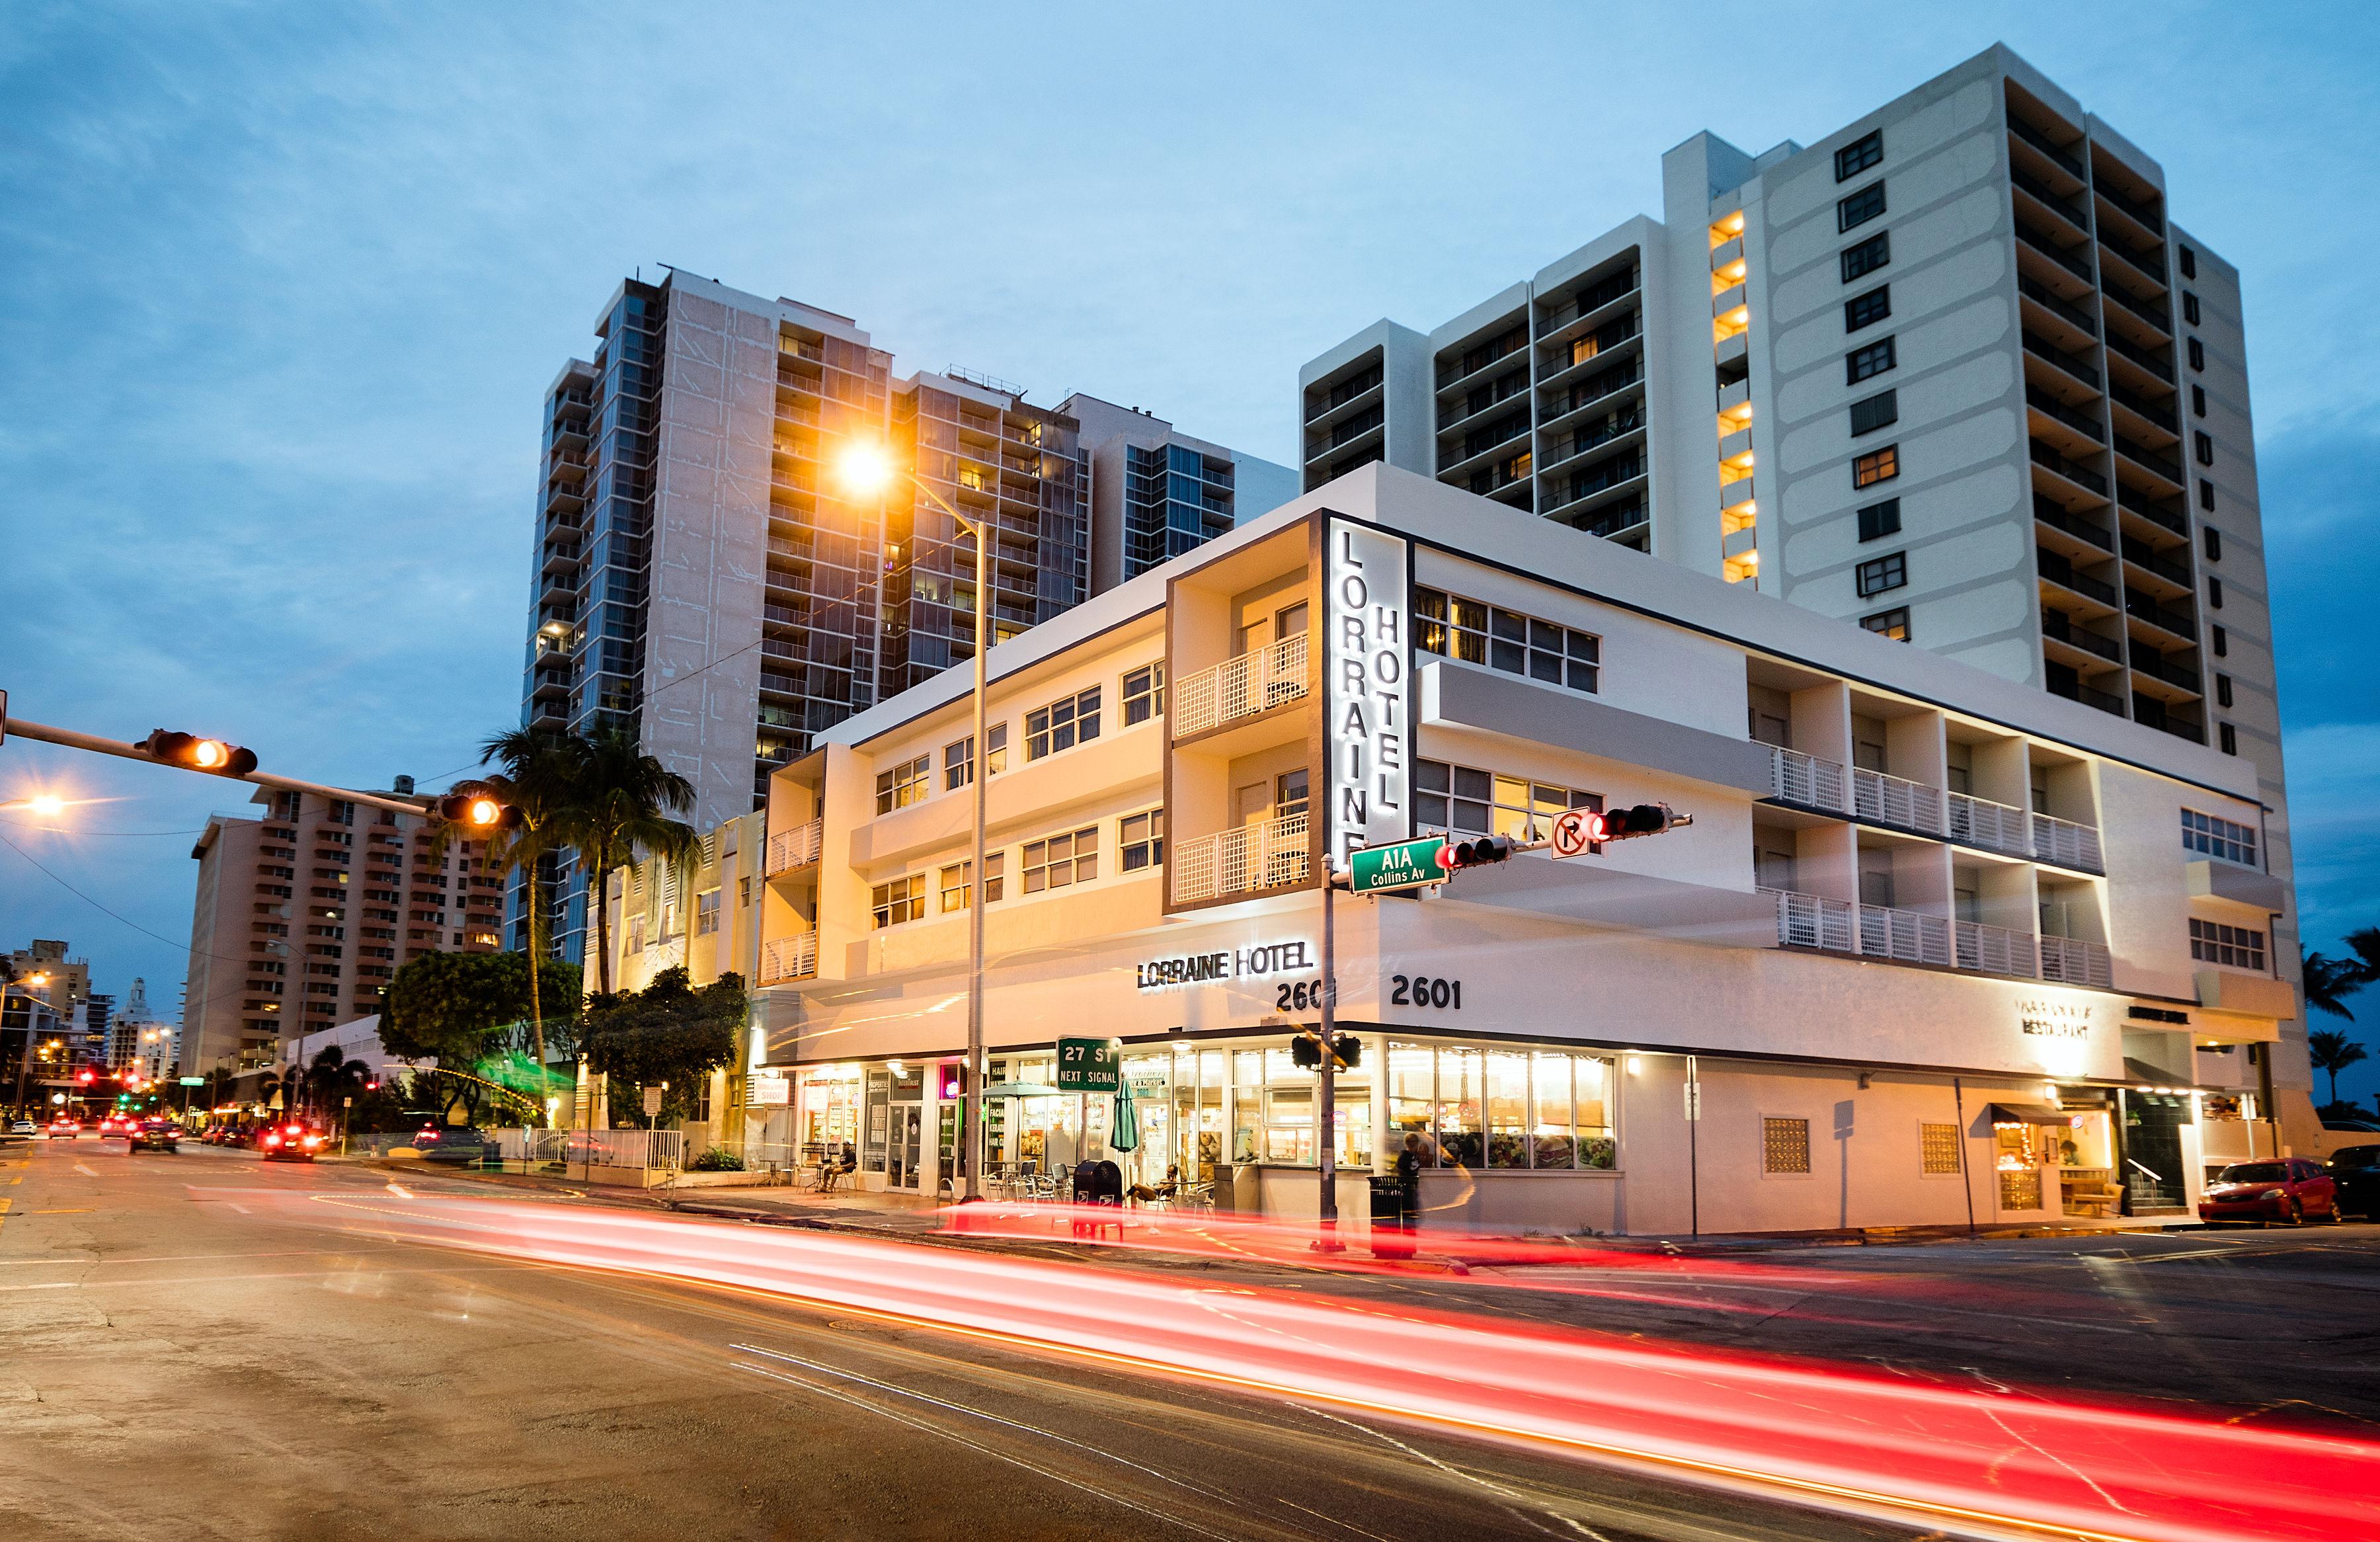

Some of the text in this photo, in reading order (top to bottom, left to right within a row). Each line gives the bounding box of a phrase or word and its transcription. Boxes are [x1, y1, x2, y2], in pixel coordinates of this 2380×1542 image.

[1374, 606, 1400, 810] HOTEL
[1382, 847, 1413, 871] A1A
[1371, 868, 1425, 886] Collins Av
[1137, 942, 1314, 989] LORRAINE HOTEL
[1392, 975, 1460, 1009] 2601
[1065, 1047, 1085, 1061] 27
[1095, 1047, 1113, 1063] ST
[1060, 1071, 1117, 1084] NEXT SIGNAL
[990, 1108, 1005, 1117] FACIA
